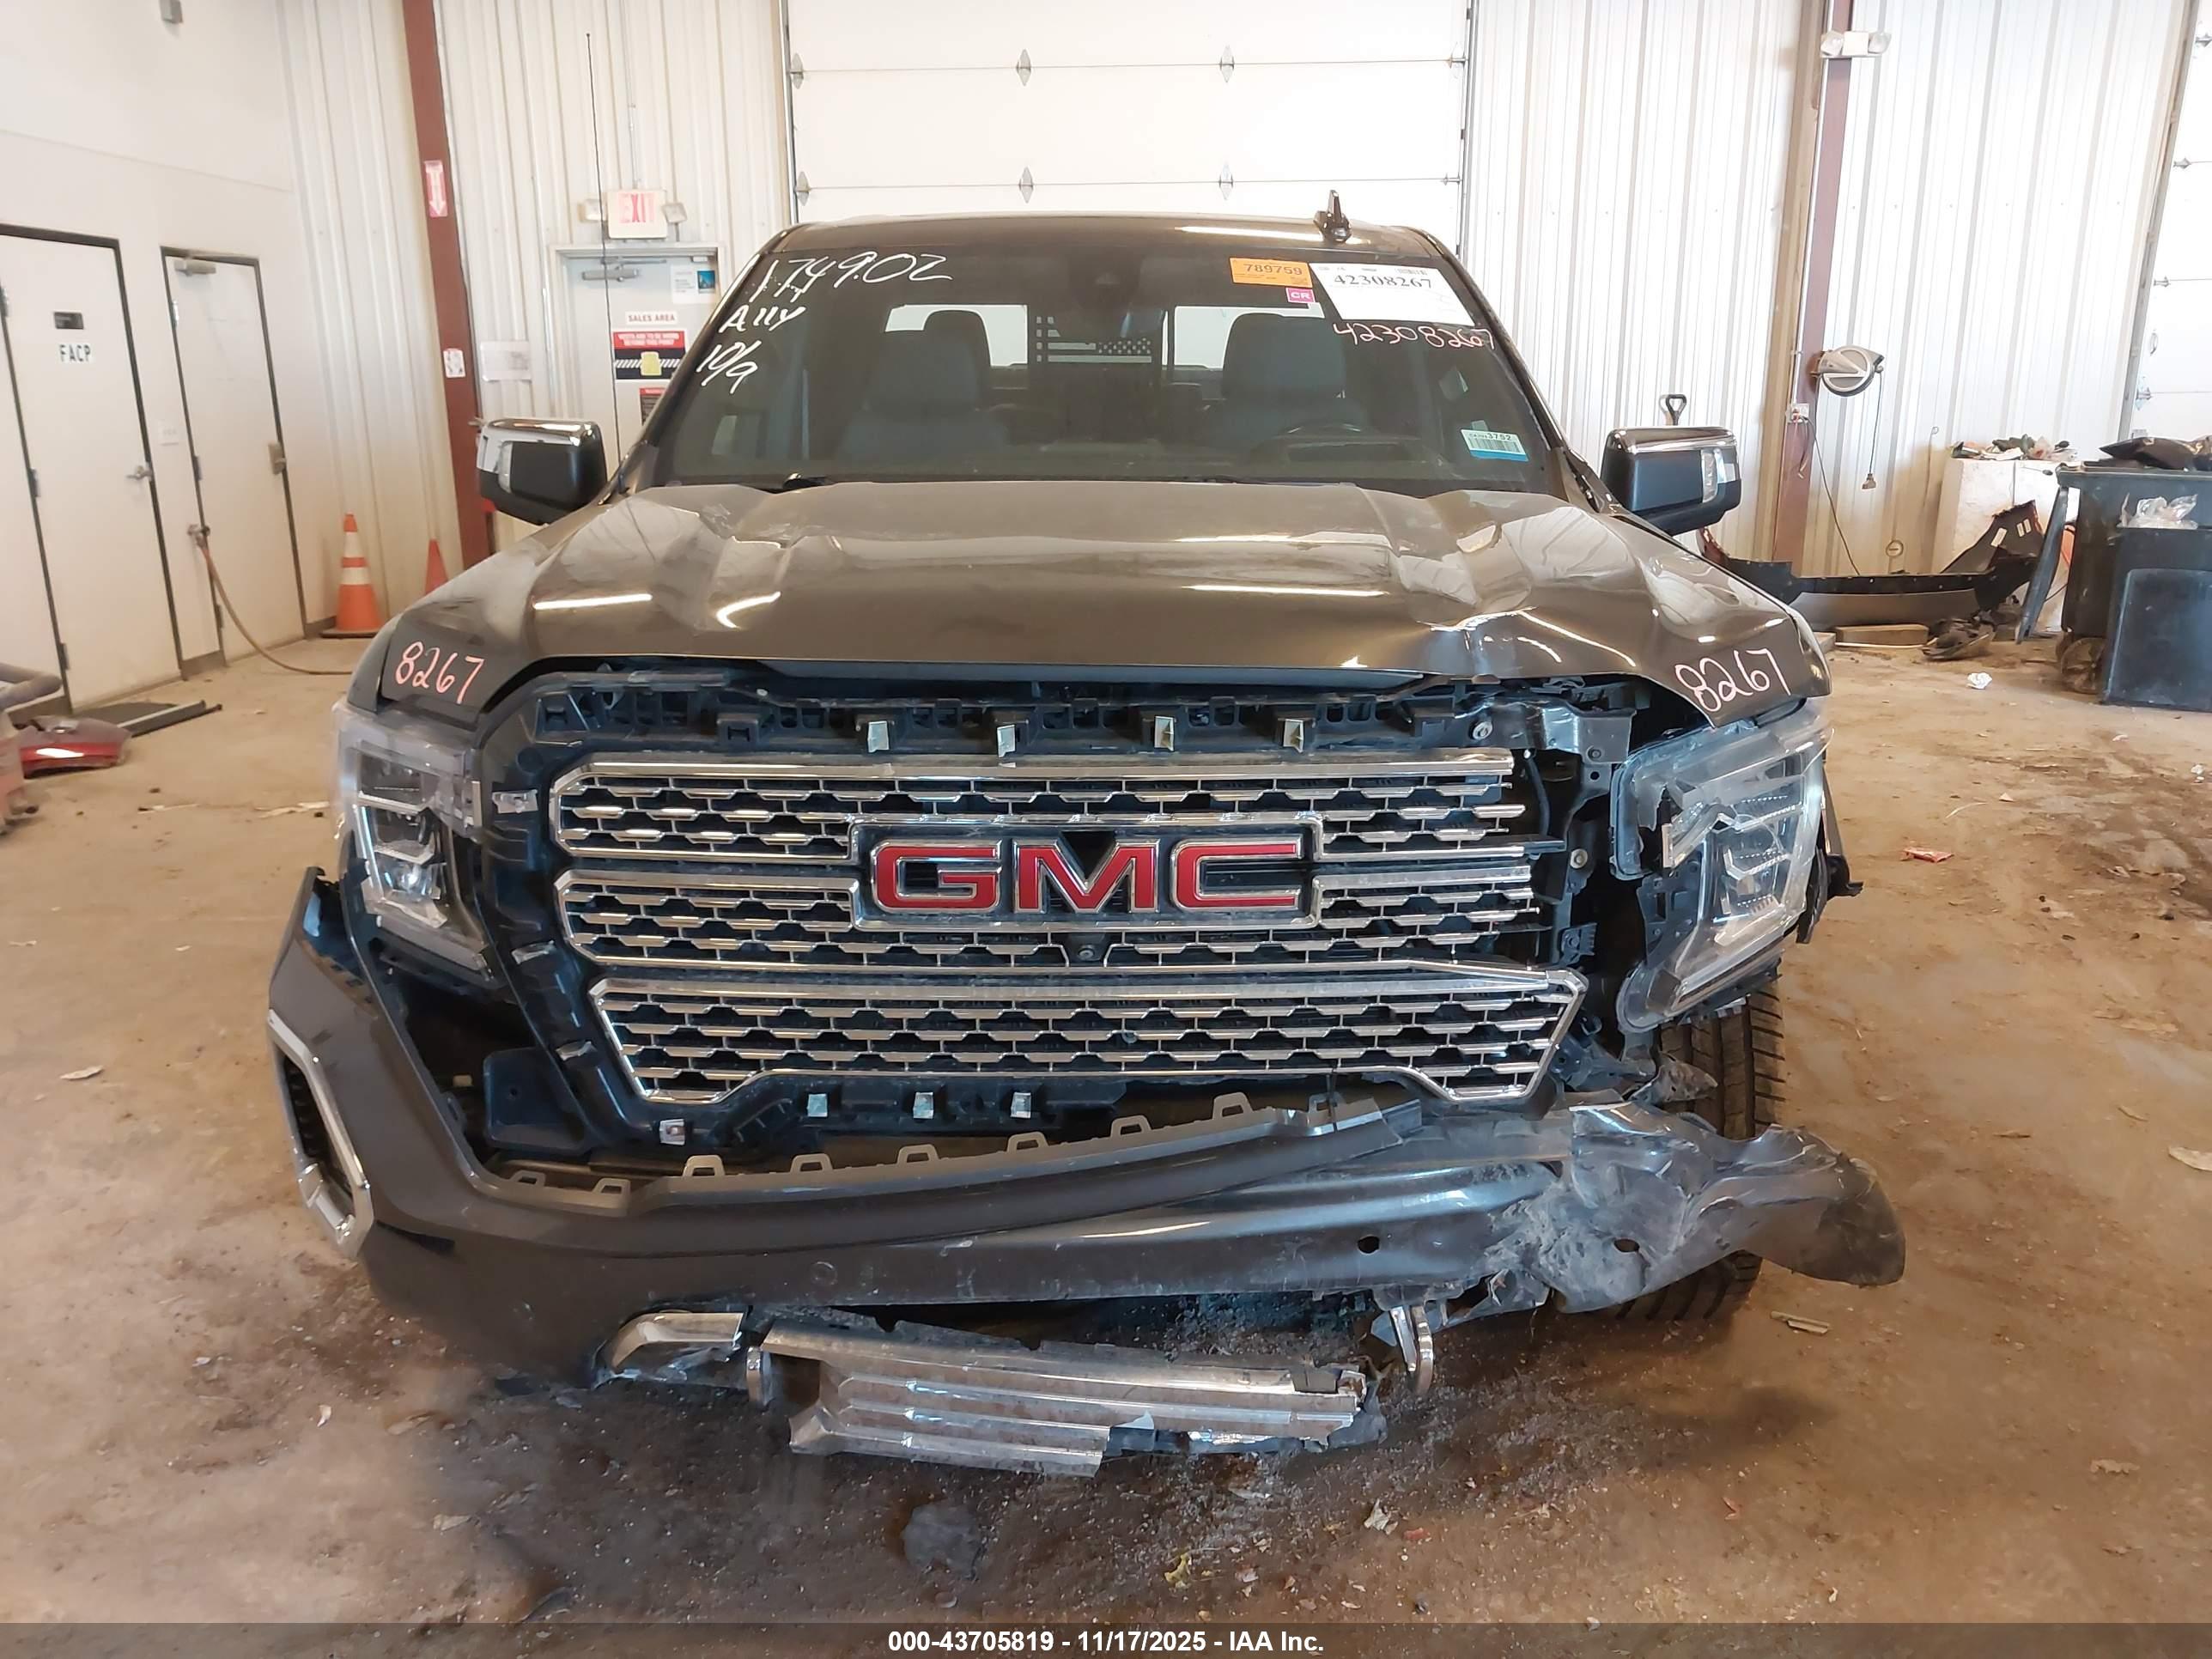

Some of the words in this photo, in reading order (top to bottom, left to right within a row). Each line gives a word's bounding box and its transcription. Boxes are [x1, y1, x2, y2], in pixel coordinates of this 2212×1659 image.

[619, 193, 655, 223] EXIT
[1243, 263, 1303, 276] 789759
[1334, 274, 1431, 289] 42308267
[1333, 323, 1494, 349] 42308267
[60, 344, 90, 362] FACP
[396, 641, 485, 704] 8267
[1674, 648, 1791, 712] 8267
[871, 837, 1304, 914] GMC
